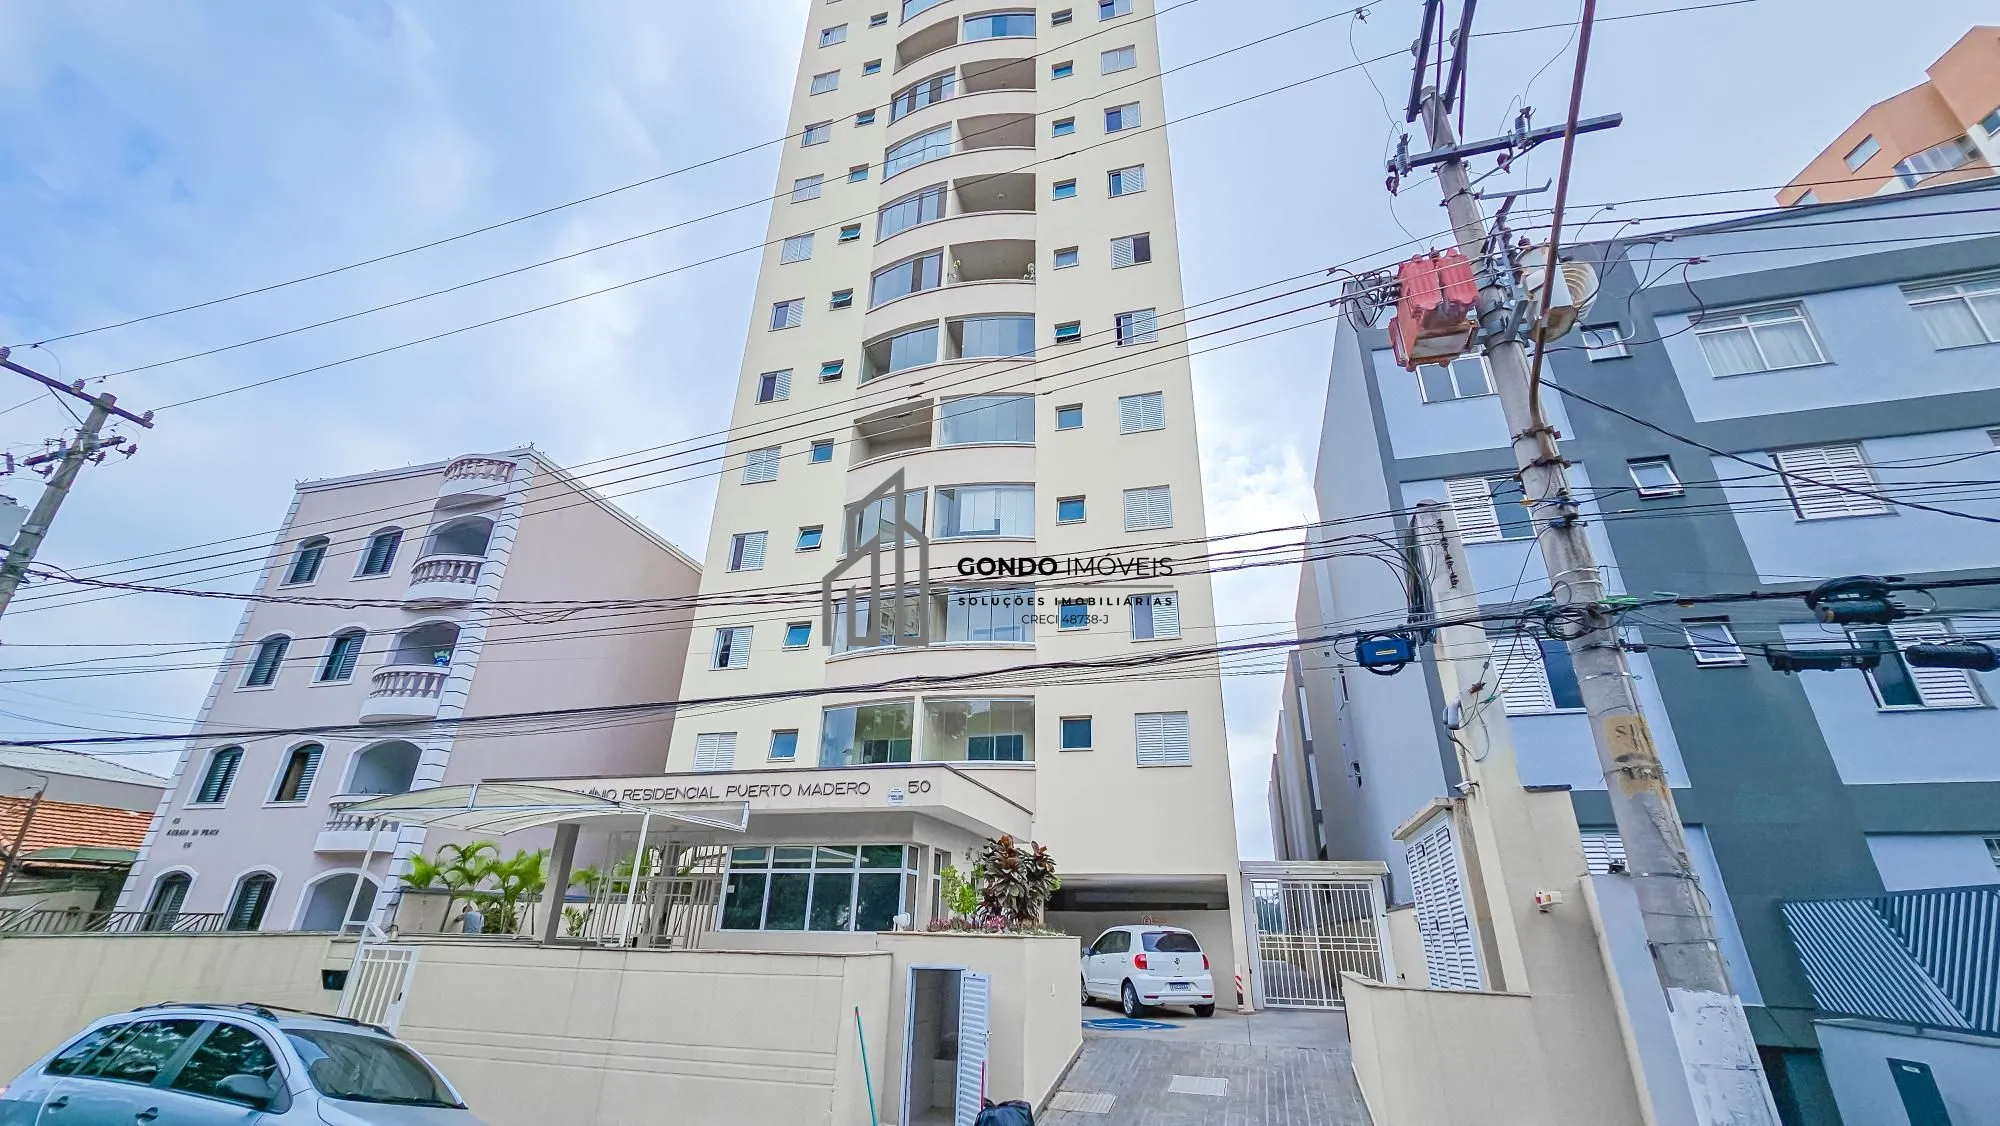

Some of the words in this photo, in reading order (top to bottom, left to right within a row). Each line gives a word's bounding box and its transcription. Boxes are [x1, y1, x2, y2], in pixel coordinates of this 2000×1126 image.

[622, 786, 720, 801] RESIDENCIAL
[726, 783, 793, 798] PUERTO
[797, 781, 871, 797] MADERO
[907, 779, 932, 794] 50
